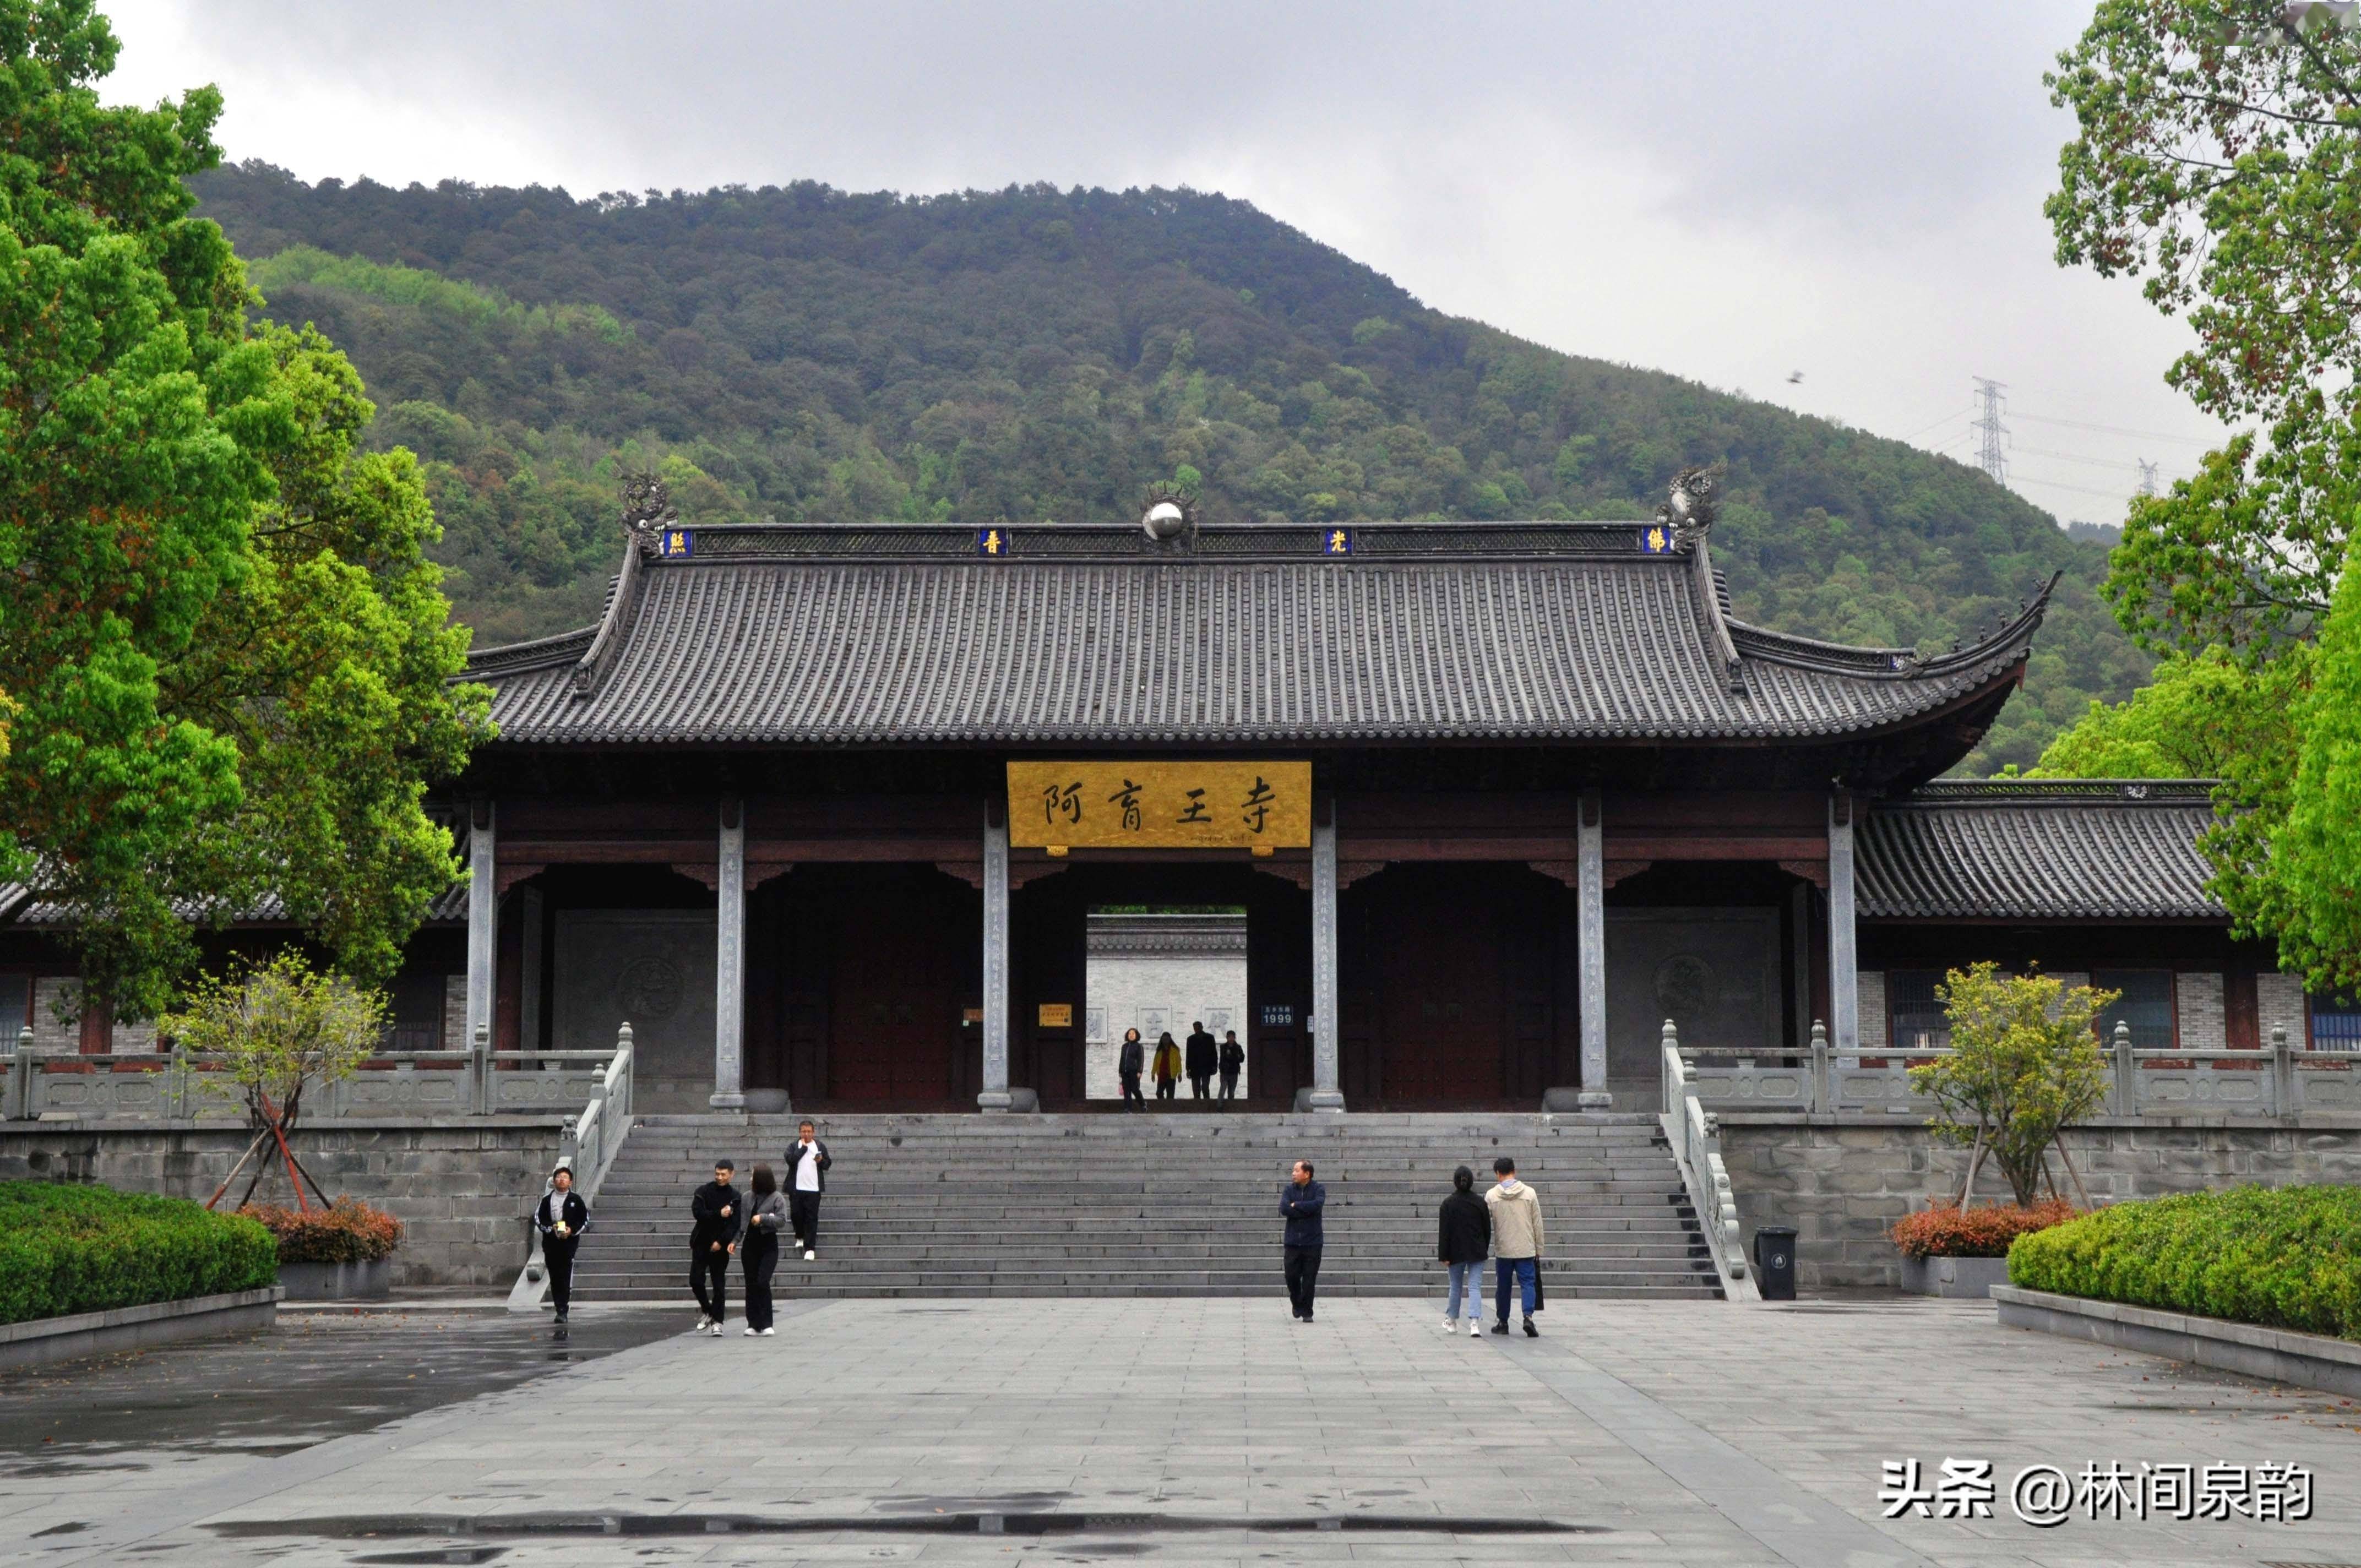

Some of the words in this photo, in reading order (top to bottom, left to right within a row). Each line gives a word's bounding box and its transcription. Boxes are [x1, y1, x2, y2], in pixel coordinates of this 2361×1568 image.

[669, 532, 686, 554] 照
[983, 530, 1002, 554] 普
[1330, 530, 1346, 553] 光
[1648, 527, 1666, 552] 佛
[1042, 776, 1275, 834] 阿育王寺
[1264, 1014, 1291, 1023] 1999
